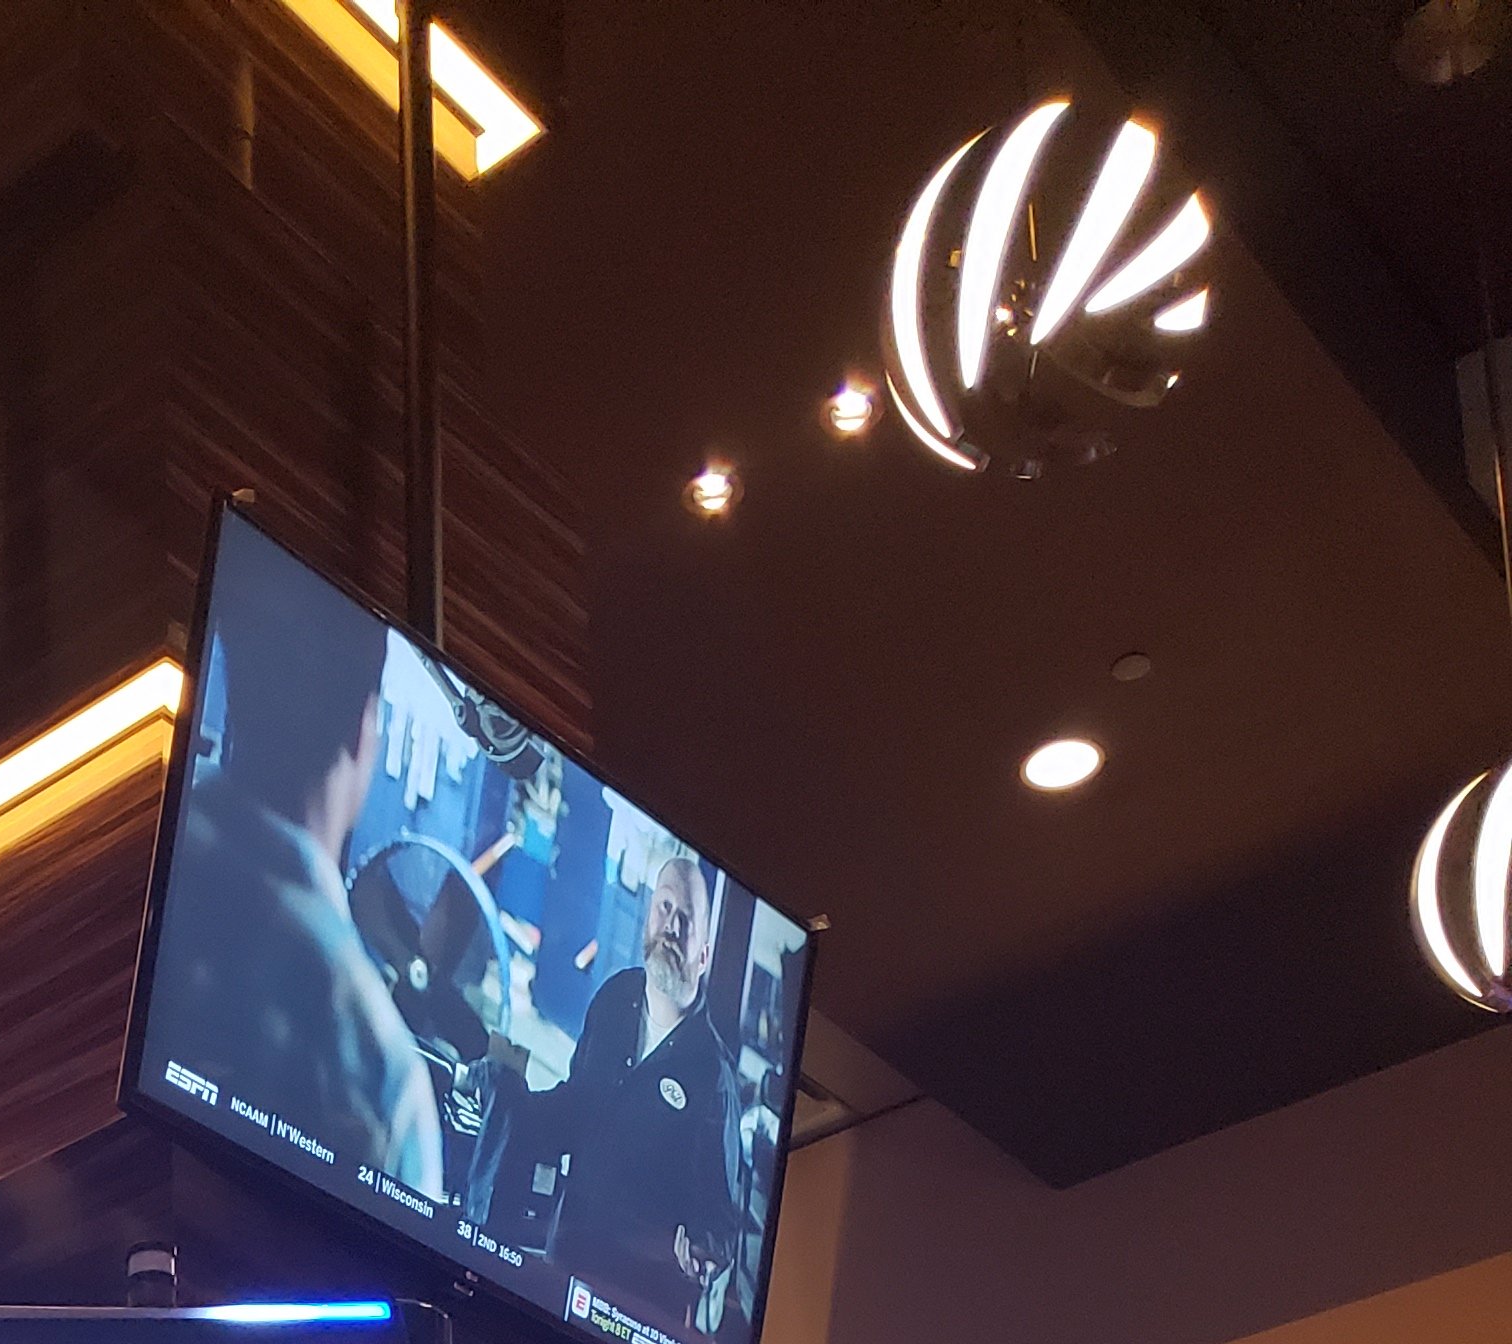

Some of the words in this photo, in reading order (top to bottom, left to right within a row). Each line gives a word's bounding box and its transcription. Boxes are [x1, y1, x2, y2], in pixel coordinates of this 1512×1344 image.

[165, 1060, 219, 1106] ESPN
[230, 1097, 268, 1128] NCAAM
[276, 1120, 335, 1164] N'Western
[357, 1166, 374, 1185] 24
[382, 1177, 434, 1219] Wisconsin
[456, 1220, 472, 1239] 38
[477, 1233, 497, 1253] 2ND
[498, 1245, 522, 1267] 16:50
[590, 1309, 615, 1334] Tonight
[621, 1326, 632, 1340] ET
